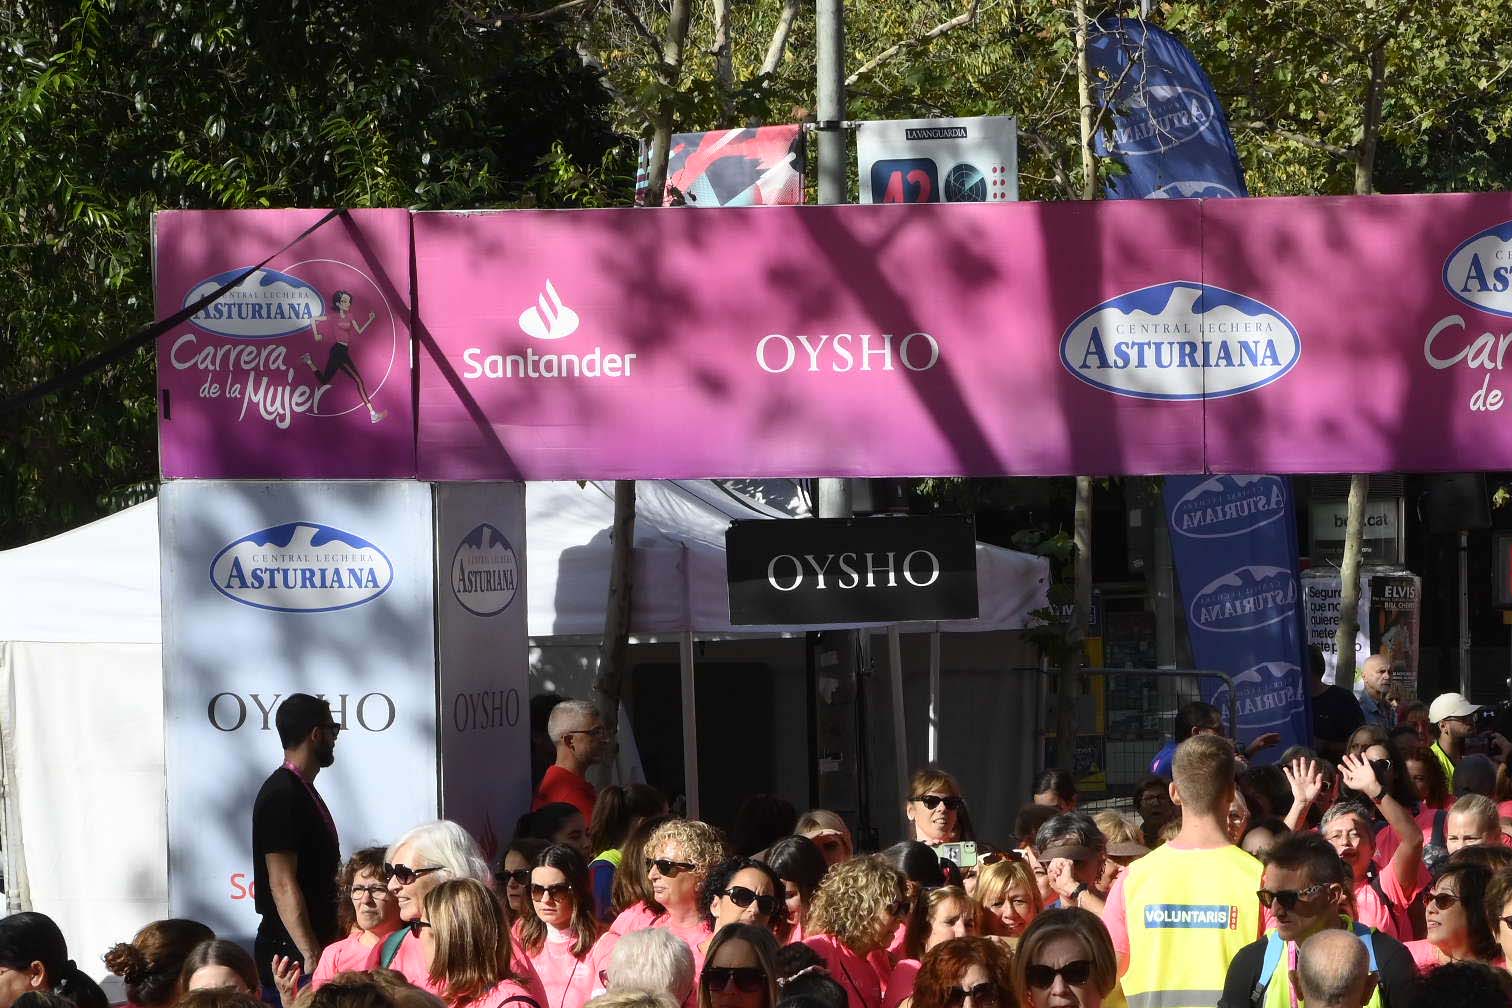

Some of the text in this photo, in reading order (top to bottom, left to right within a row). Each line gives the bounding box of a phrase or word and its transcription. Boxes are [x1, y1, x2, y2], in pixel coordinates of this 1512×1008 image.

[1115, 322, 1192, 335] CENTRAL
[169, 334, 288, 372] Carrera
[463, 347, 637, 380] Santander
[755, 331, 940, 374] OYSHO
[1079, 325, 1282, 371] ASTURIANA
[199, 366, 333, 429] de la Mujer
[1469, 373, 1504, 412] de
[225, 556, 380, 590] ASTURIANA
[252, 553, 375, 563] CENTRAL LECHERA
[456, 558, 515, 594] ASTURIANA
[767, 549, 940, 591] OYSHO
[1384, 586, 1416, 599] ELVIS
[454, 688, 520, 733] OYSHO
[1145, 909, 1227, 923] VOLUNTARIS
